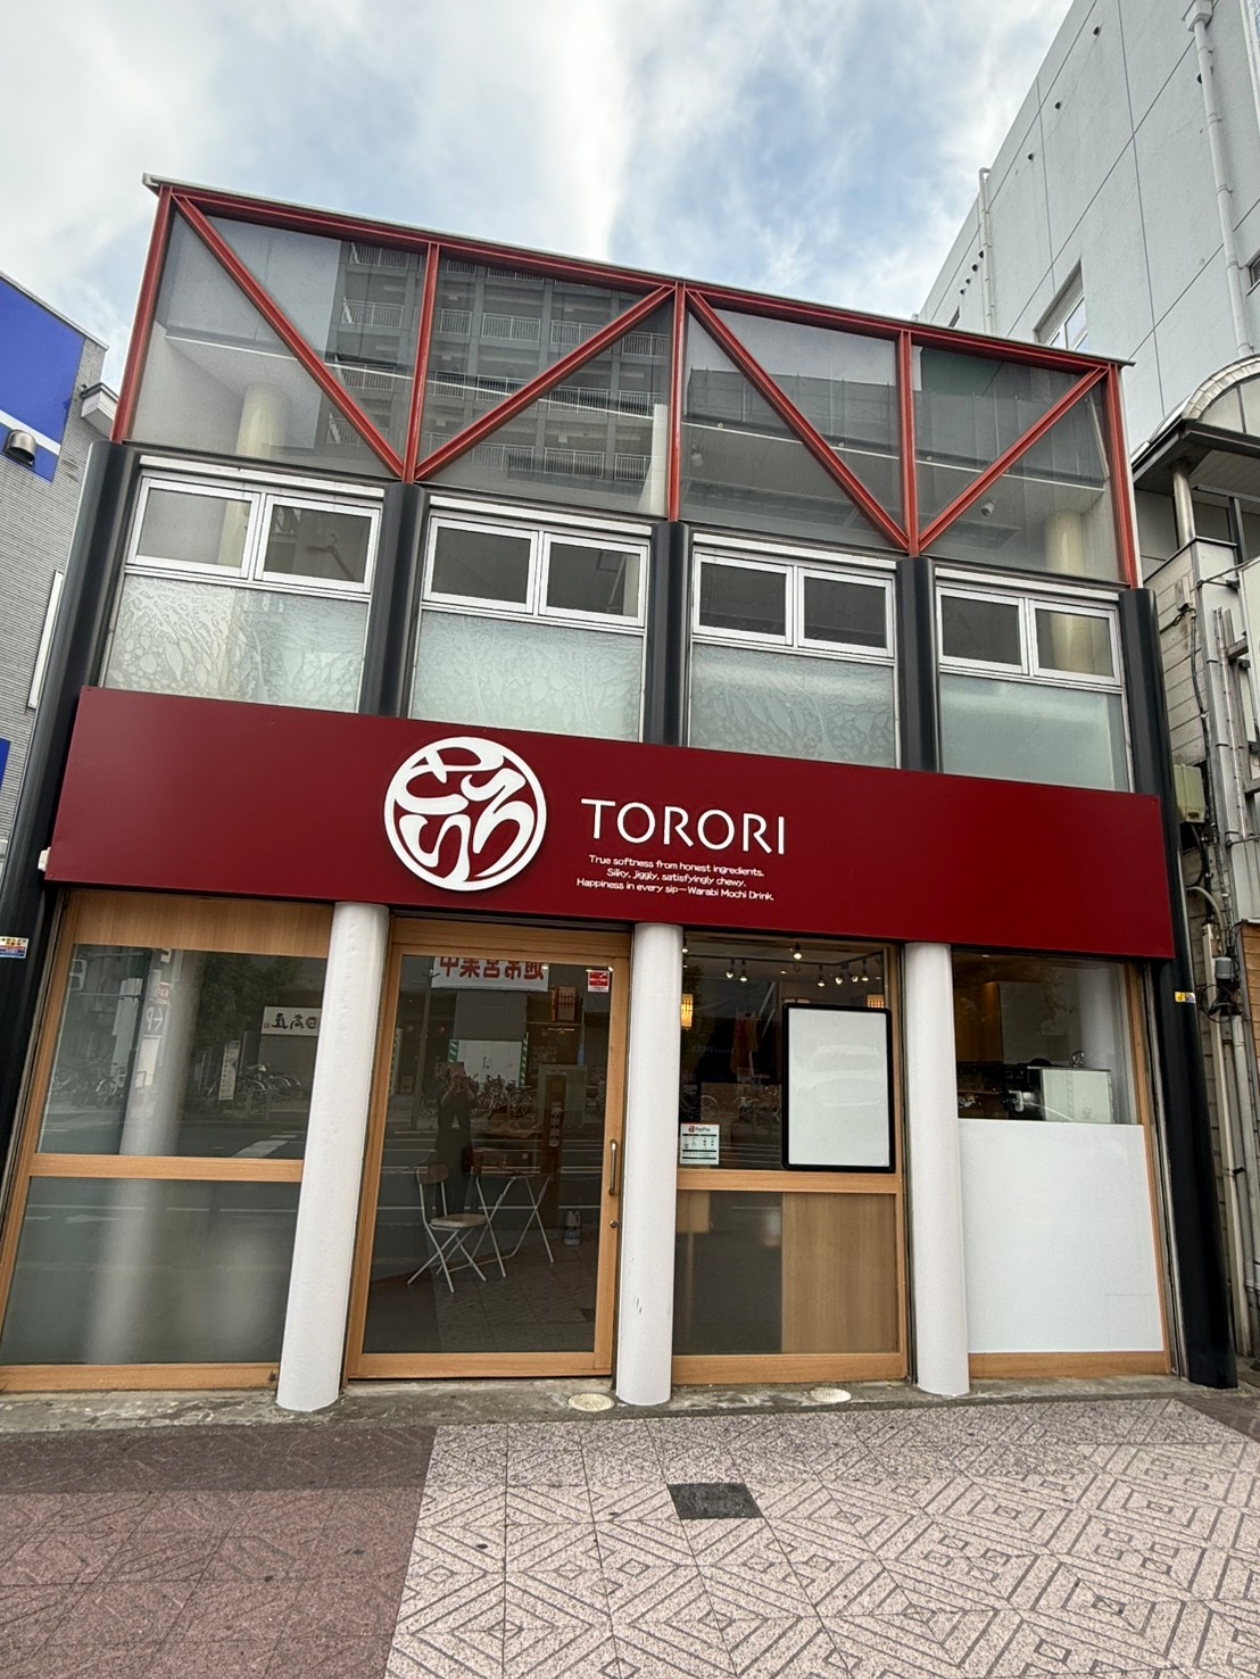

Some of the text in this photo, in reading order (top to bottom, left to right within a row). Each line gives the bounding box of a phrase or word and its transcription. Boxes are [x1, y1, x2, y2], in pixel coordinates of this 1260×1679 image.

[581, 798, 785, 855] TORORI
[588, 854, 611, 865] True
[613, 857, 654, 869] softness
[656, 860, 678, 870] from
[680, 862, 711, 873] honest
[576, 878, 624, 890] Happiness
[626, 881, 635, 890] in
[636, 884, 663, 894] every
[721, 888, 747, 899] Mochi
[748, 890, 775, 901] Drink.
[661, 873, 714, 886] satisfyingly
[716, 877, 747, 888] chewy.
